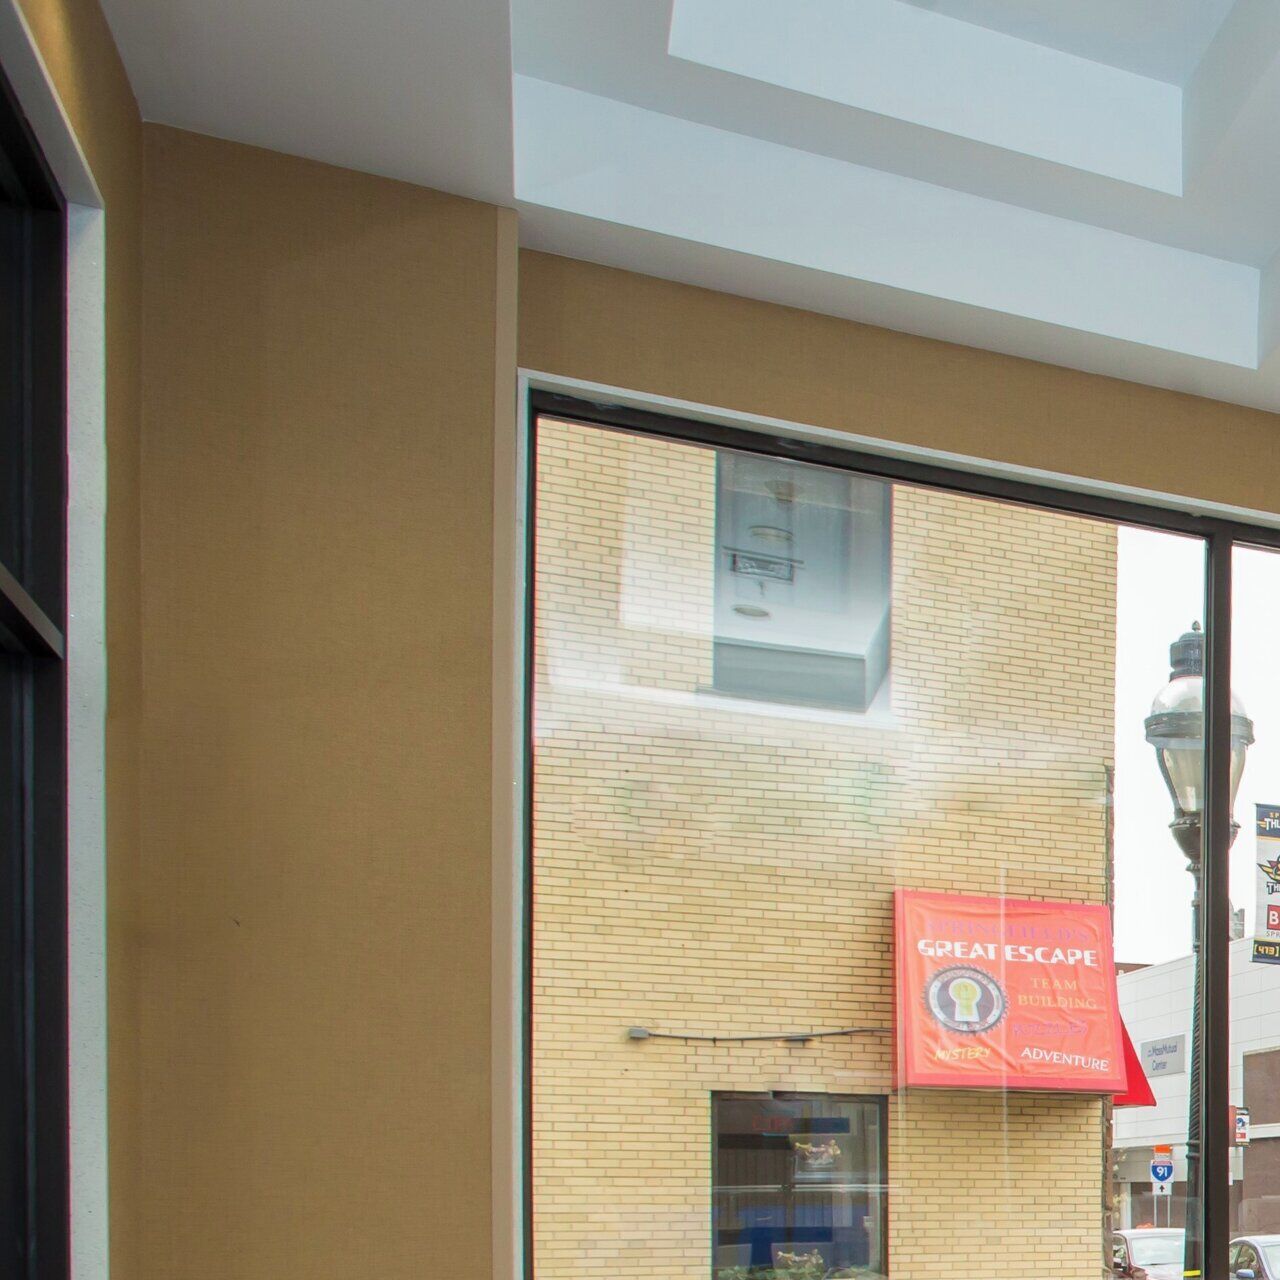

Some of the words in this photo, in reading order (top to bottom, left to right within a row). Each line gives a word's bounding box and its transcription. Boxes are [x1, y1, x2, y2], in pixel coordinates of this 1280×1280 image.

[917, 939, 999, 961] GREAT
[1004, 943, 1099, 967] ESCAPE
[1031, 977, 1078, 991] TEAM
[1018, 994, 1098, 1010] BUILDING
[933, 1047, 992, 1062] MYSTERY
[1020, 1046, 1110, 1072] ADVENTURE
[1156, 1166, 1168, 1177] 91
